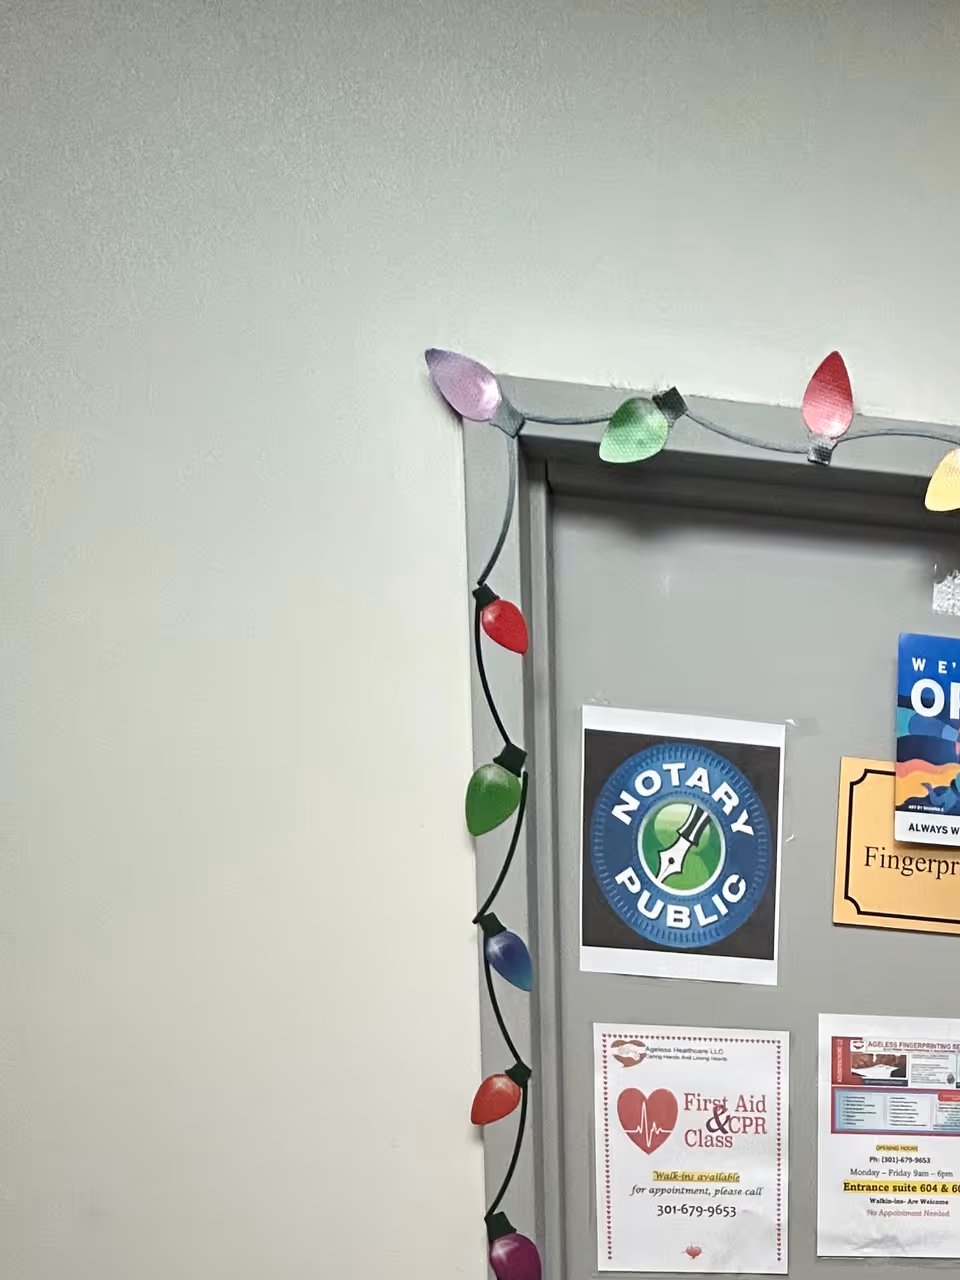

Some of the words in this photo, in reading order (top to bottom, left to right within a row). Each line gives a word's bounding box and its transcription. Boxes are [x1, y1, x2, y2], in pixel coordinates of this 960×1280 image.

[611, 763, 755, 836] NOTARY
[909, 823, 948, 834] ALWAYS
[614, 867, 747, 929] PUBLIC
[899, 1042, 950, 1050] FINGERPRINTING
[684, 1093, 728, 1111] First
[735, 1094, 767, 1112] Aid
[705, 1104, 731, 1134] &
[728, 1116, 767, 1134] CPR
[684, 1129, 733, 1148] Class
[881, 1156, 930, 1164] (301)-679-9653
[653, 1171, 694, 1181] Walk-ins
[697, 1172, 740, 1182] available
[850, 1168, 880, 1178] Monday
[888, 1169, 911, 1178] Friday
[937, 1170, 953, 1179] 6pm
[630, 1184, 645, 1196] for
[648, 1187, 711, 1197] appointment,
[713, 1187, 742, 1197] please
[744, 1187, 763, 1196] call
[843, 1182, 889, 1192] Entrance
[892, 1184, 917, 1192] suite
[920, 1184, 938, 1193] 604
[940, 1184, 949, 1193] &
[657, 1204, 736, 1217] 301-679-9653
[878, 1209, 922, 1217] Appointment
